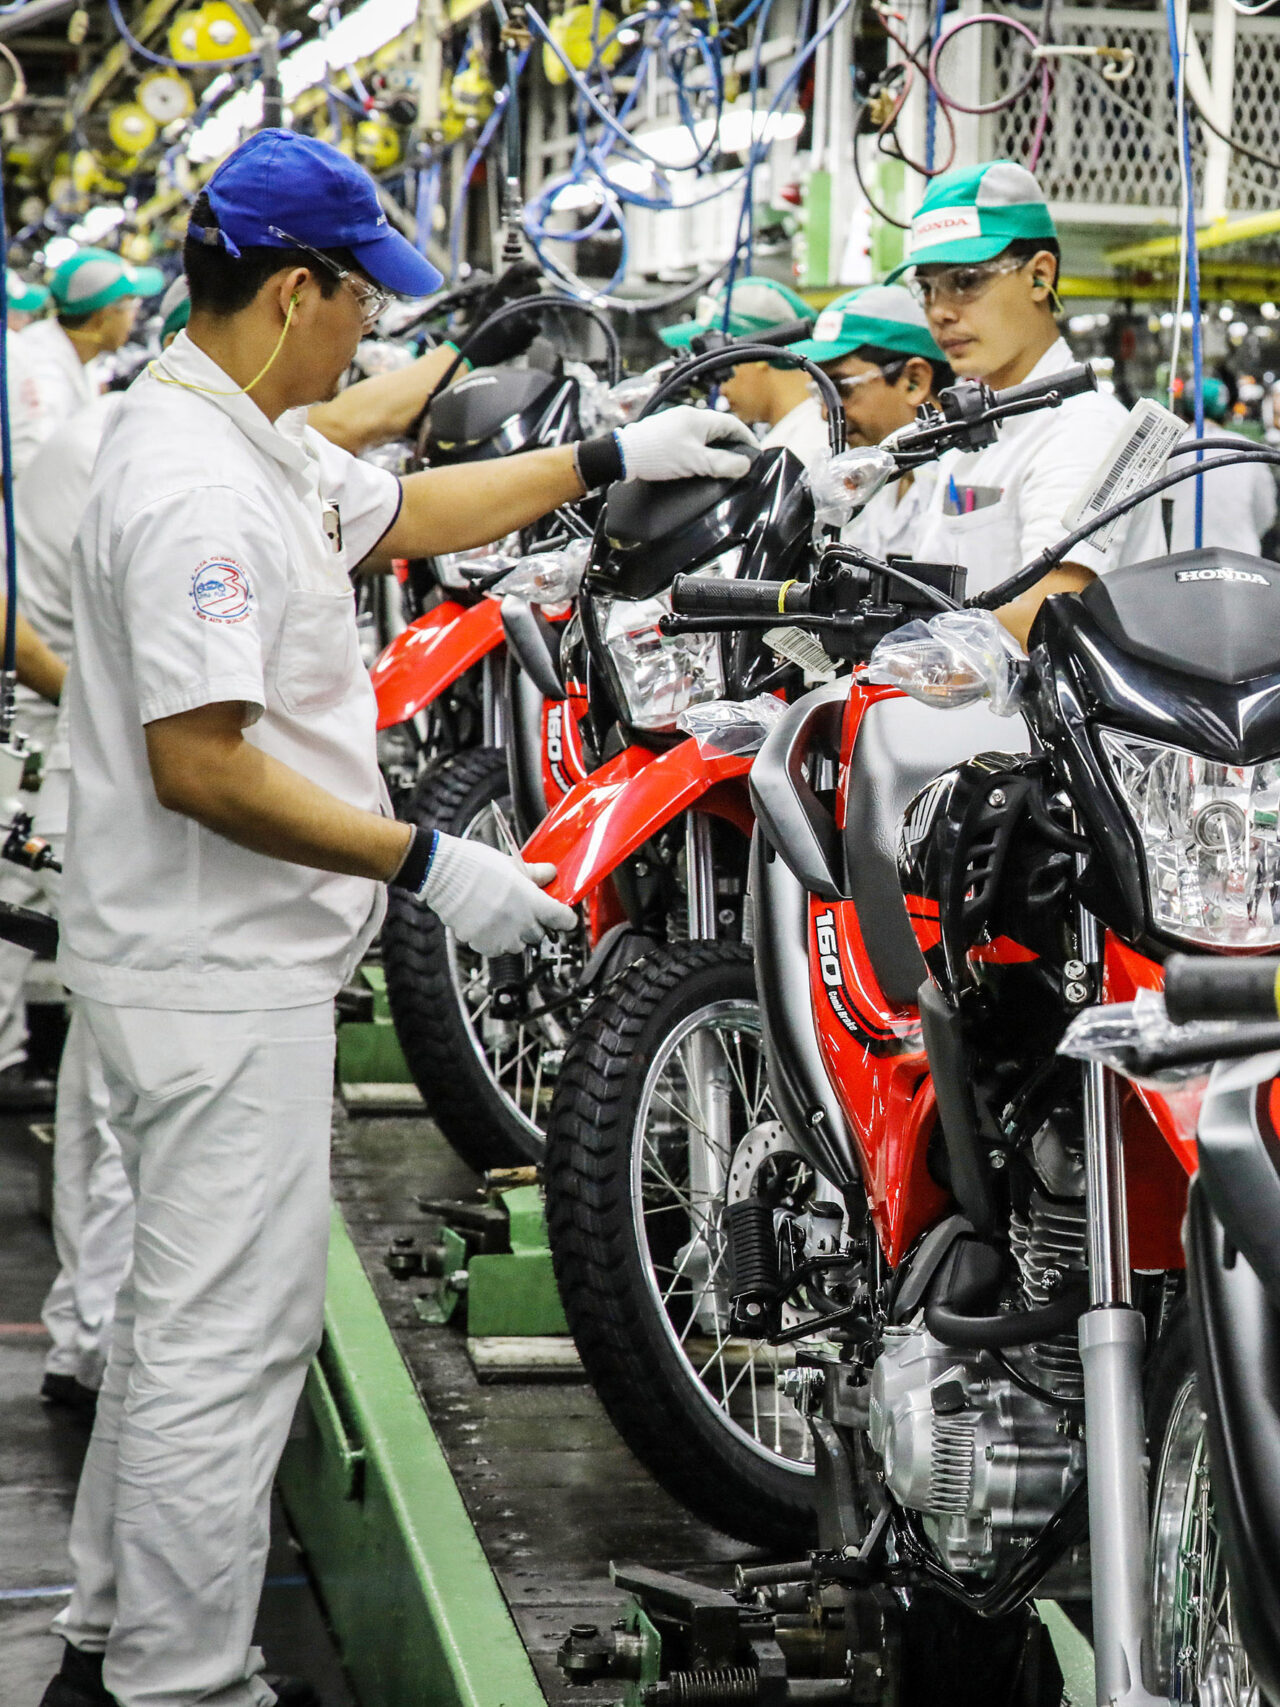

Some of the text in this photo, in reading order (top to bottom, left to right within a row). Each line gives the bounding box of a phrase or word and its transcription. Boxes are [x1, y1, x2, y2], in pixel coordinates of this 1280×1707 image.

[1176, 566, 1271, 586] HONDA
[547, 704, 563, 761] 160
[815, 908, 843, 987] 160
[828, 990, 858, 1031] Combi Brake
